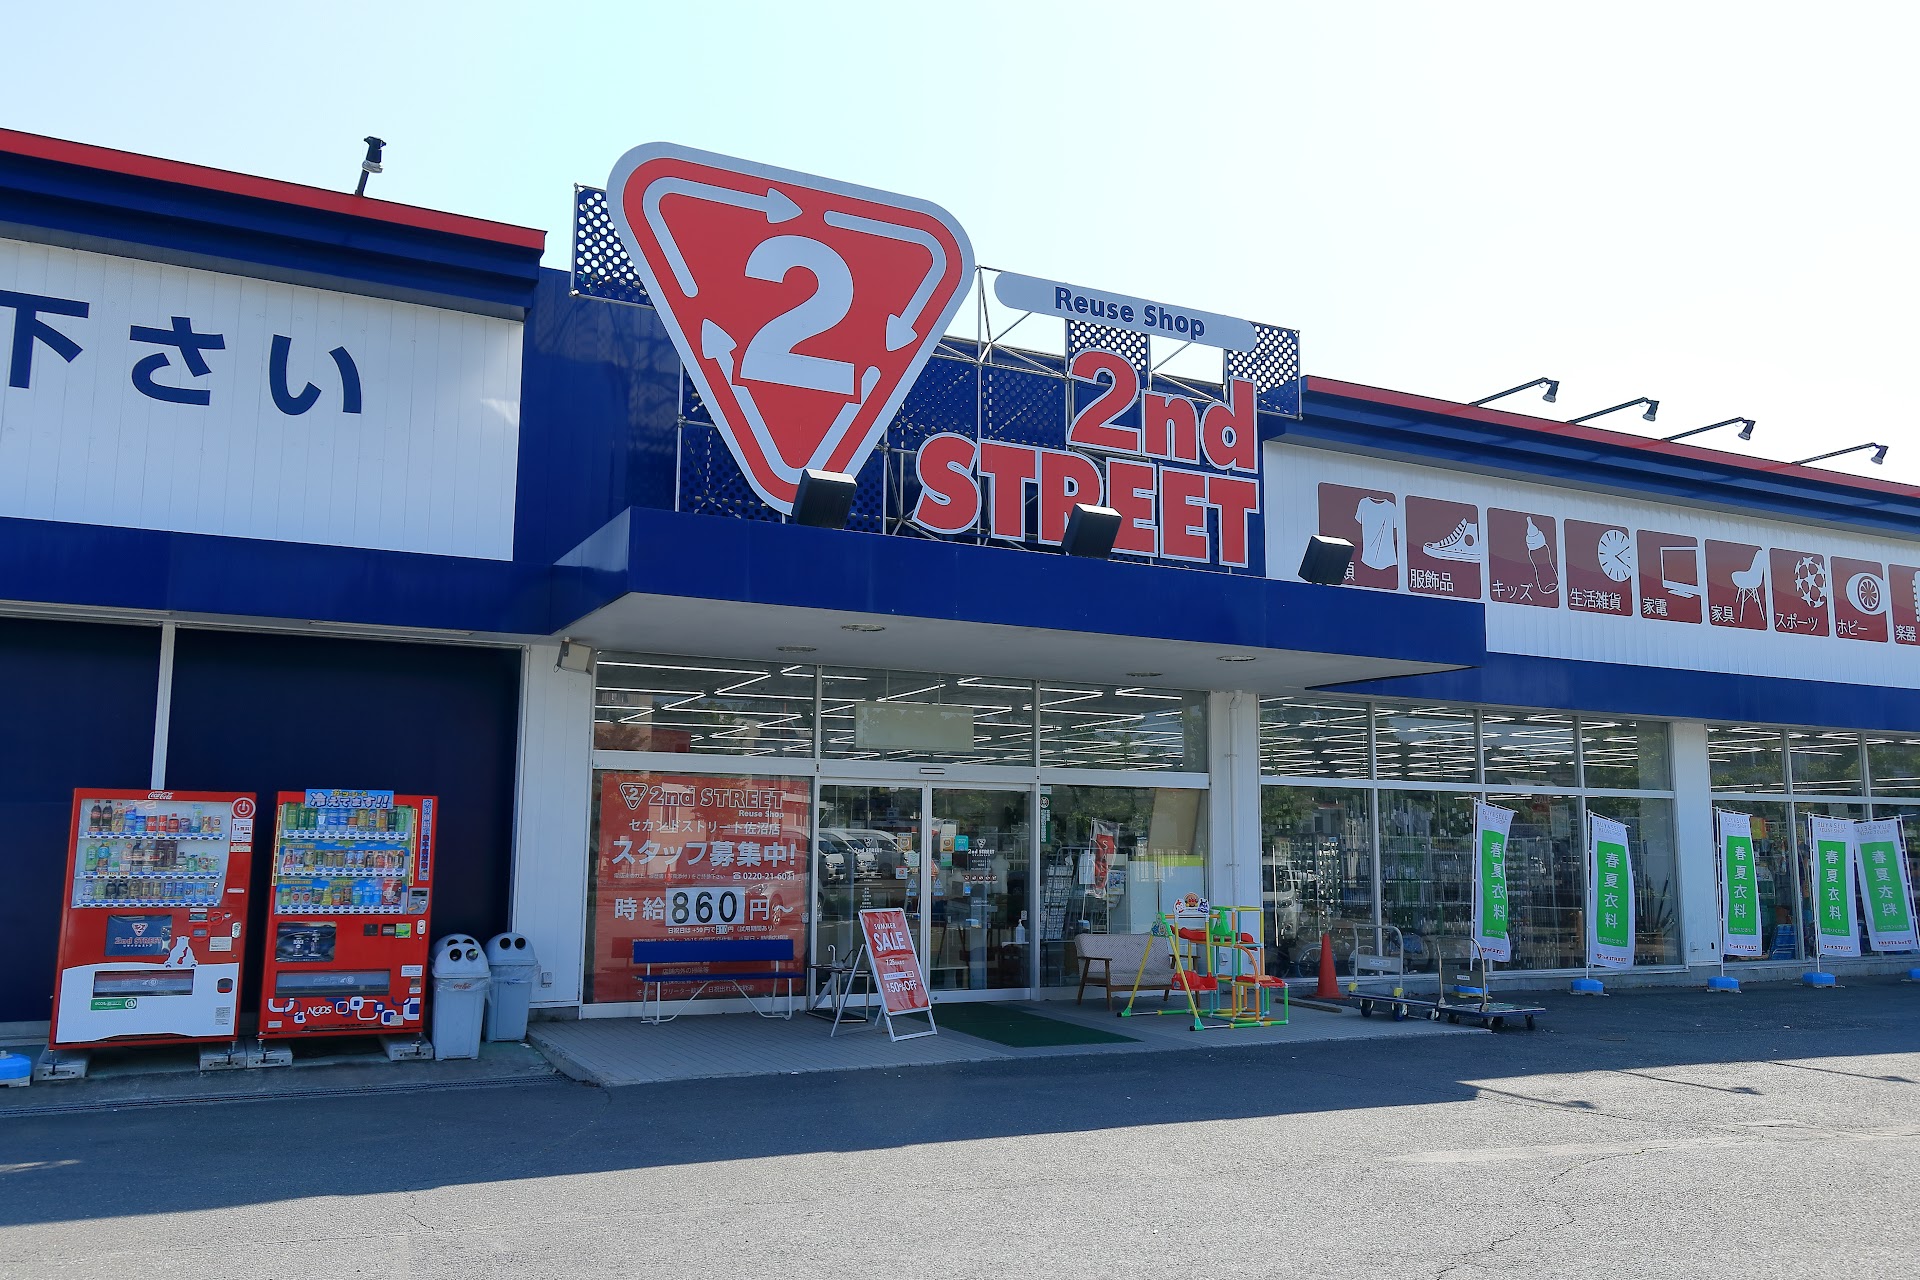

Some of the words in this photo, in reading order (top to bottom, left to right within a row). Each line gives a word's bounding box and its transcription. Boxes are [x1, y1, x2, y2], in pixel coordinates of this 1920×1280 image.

[740, 234, 855, 396] 2
[1054, 286, 1135, 323] Reuse
[1143, 305, 1206, 341] Shop
[0, 289, 362, 415] 下さい
[1066, 347, 1258, 474] 2nd
[912, 431, 1260, 569] STREET
[1410, 569, 1454, 593] 服飾品
[1492, 580, 1534, 601] キッズ
[1570, 588, 1622, 612] 生活雑貨
[1642, 597, 1668, 617] 家電
[1710, 604, 1735, 623] 家具
[1776, 613, 1819, 632] スポーツ
[1837, 620, 1868, 636] ホビー
[1896, 625, 1917, 642] 楽器
[648, 785, 695, 807] 2nd
[700, 788, 786, 810] STREET
[738, 809, 763, 818] Reuse
[765, 810, 785, 819] Shop
[628, 818, 781, 835] セカンドストリート佐沼店
[611, 839, 796, 867] スタッフ募集中!
[743, 871, 796, 881] 0220-21-6031
[1490, 841, 1506, 921] 春夏衣料
[1733, 846, 1748, 918] 春夏衣料
[1825, 849, 1841, 920] 春夏衣料
[1604, 852, 1620, 929] 春夏衣料
[613, 897, 665, 921] 時給
[671, 890, 738, 925] 860
[873, 922, 897, 930] SUMMER
[114, 937, 133, 945] 2nd
[134, 937, 162, 945] STREET
[873, 931, 906, 952] SALE
